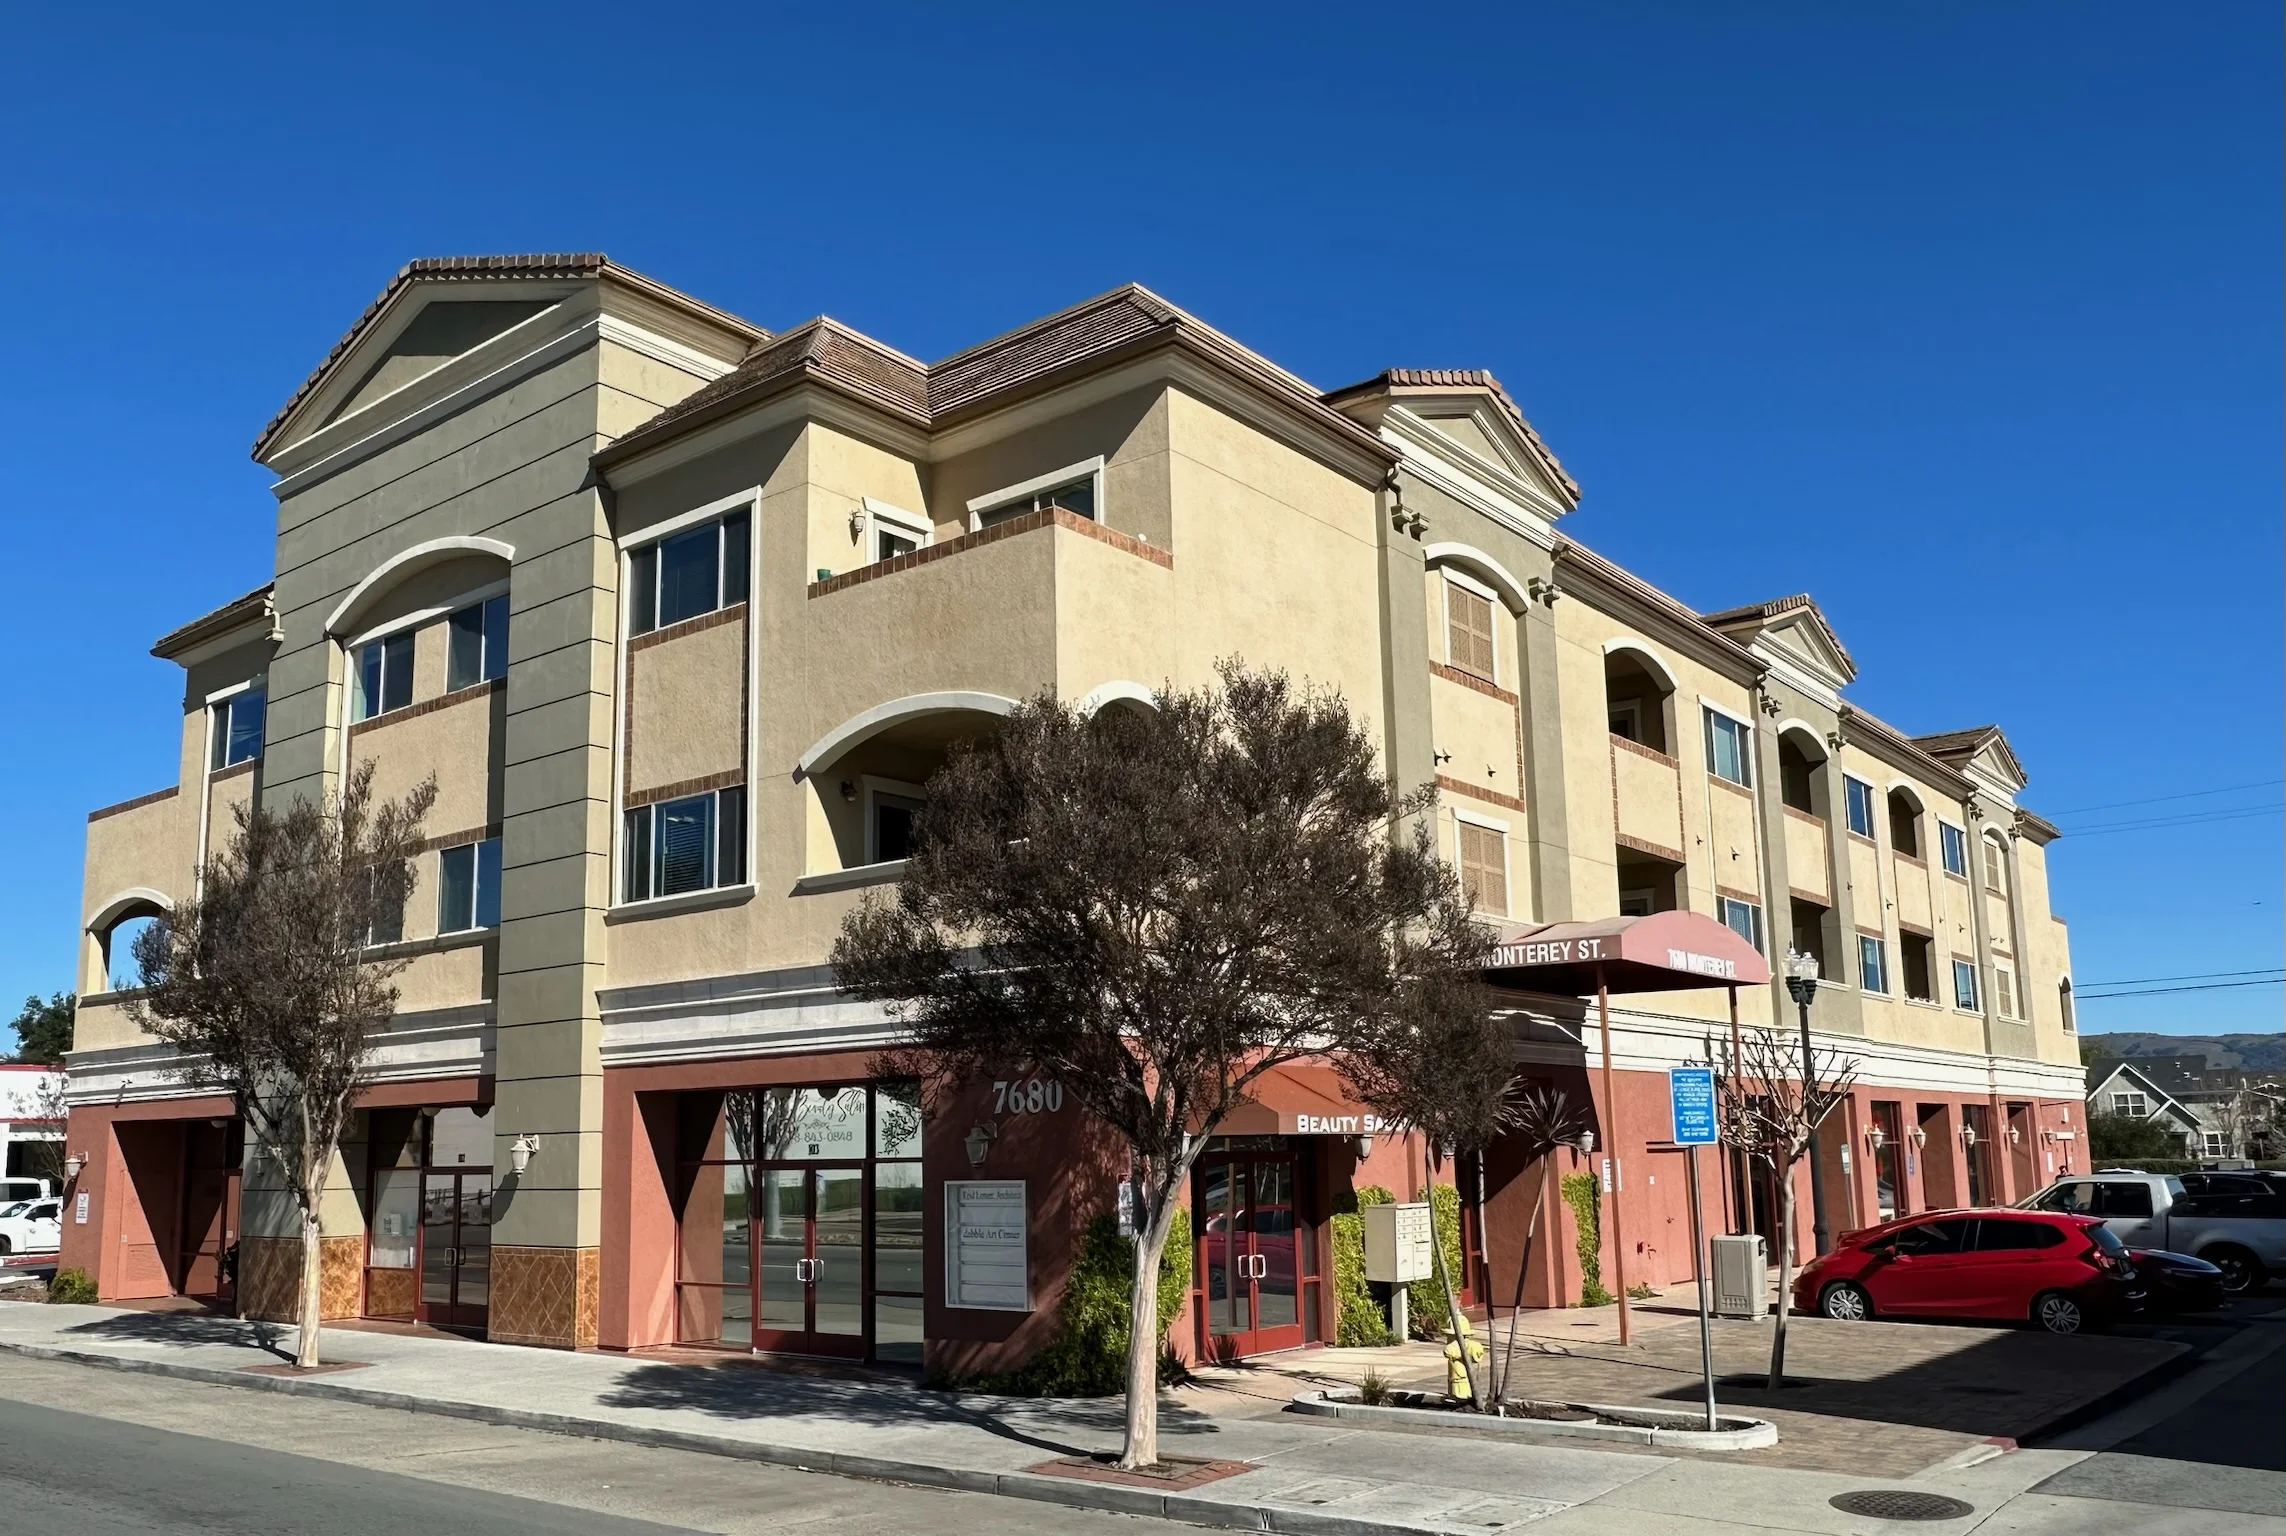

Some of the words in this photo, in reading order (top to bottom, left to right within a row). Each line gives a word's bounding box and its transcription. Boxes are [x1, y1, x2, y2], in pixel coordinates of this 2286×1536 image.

[1578, 939, 1606, 959] ST.
[992, 1079, 1063, 1114] 7680
[1297, 1114, 1359, 1133] BEAUTY
